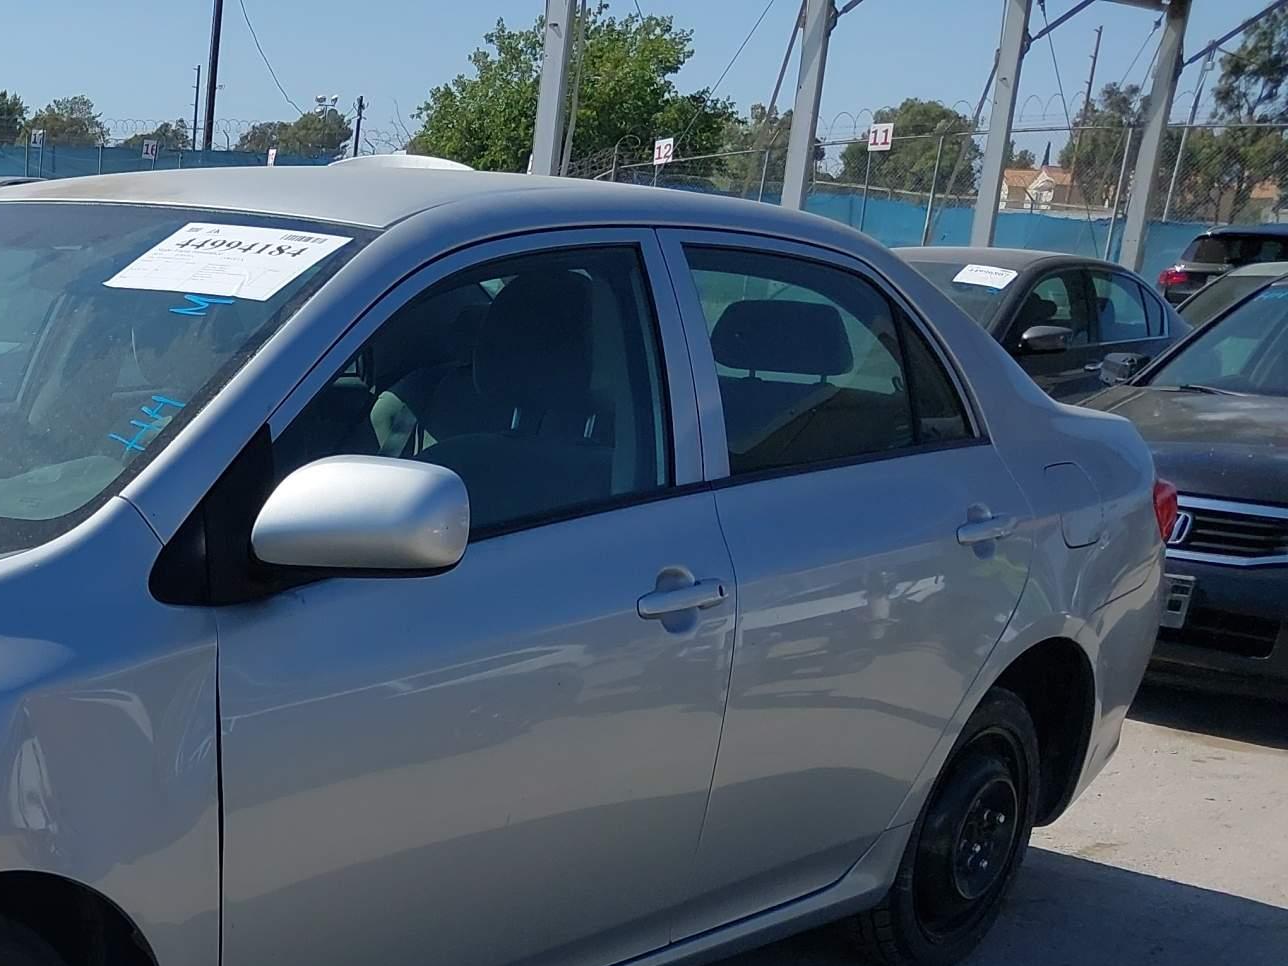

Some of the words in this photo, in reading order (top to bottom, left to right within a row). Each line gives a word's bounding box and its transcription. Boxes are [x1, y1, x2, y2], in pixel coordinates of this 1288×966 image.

[870, 129, 889, 145] 11
[655, 143, 672, 160] 12
[176, 238, 309, 258] 44994184
